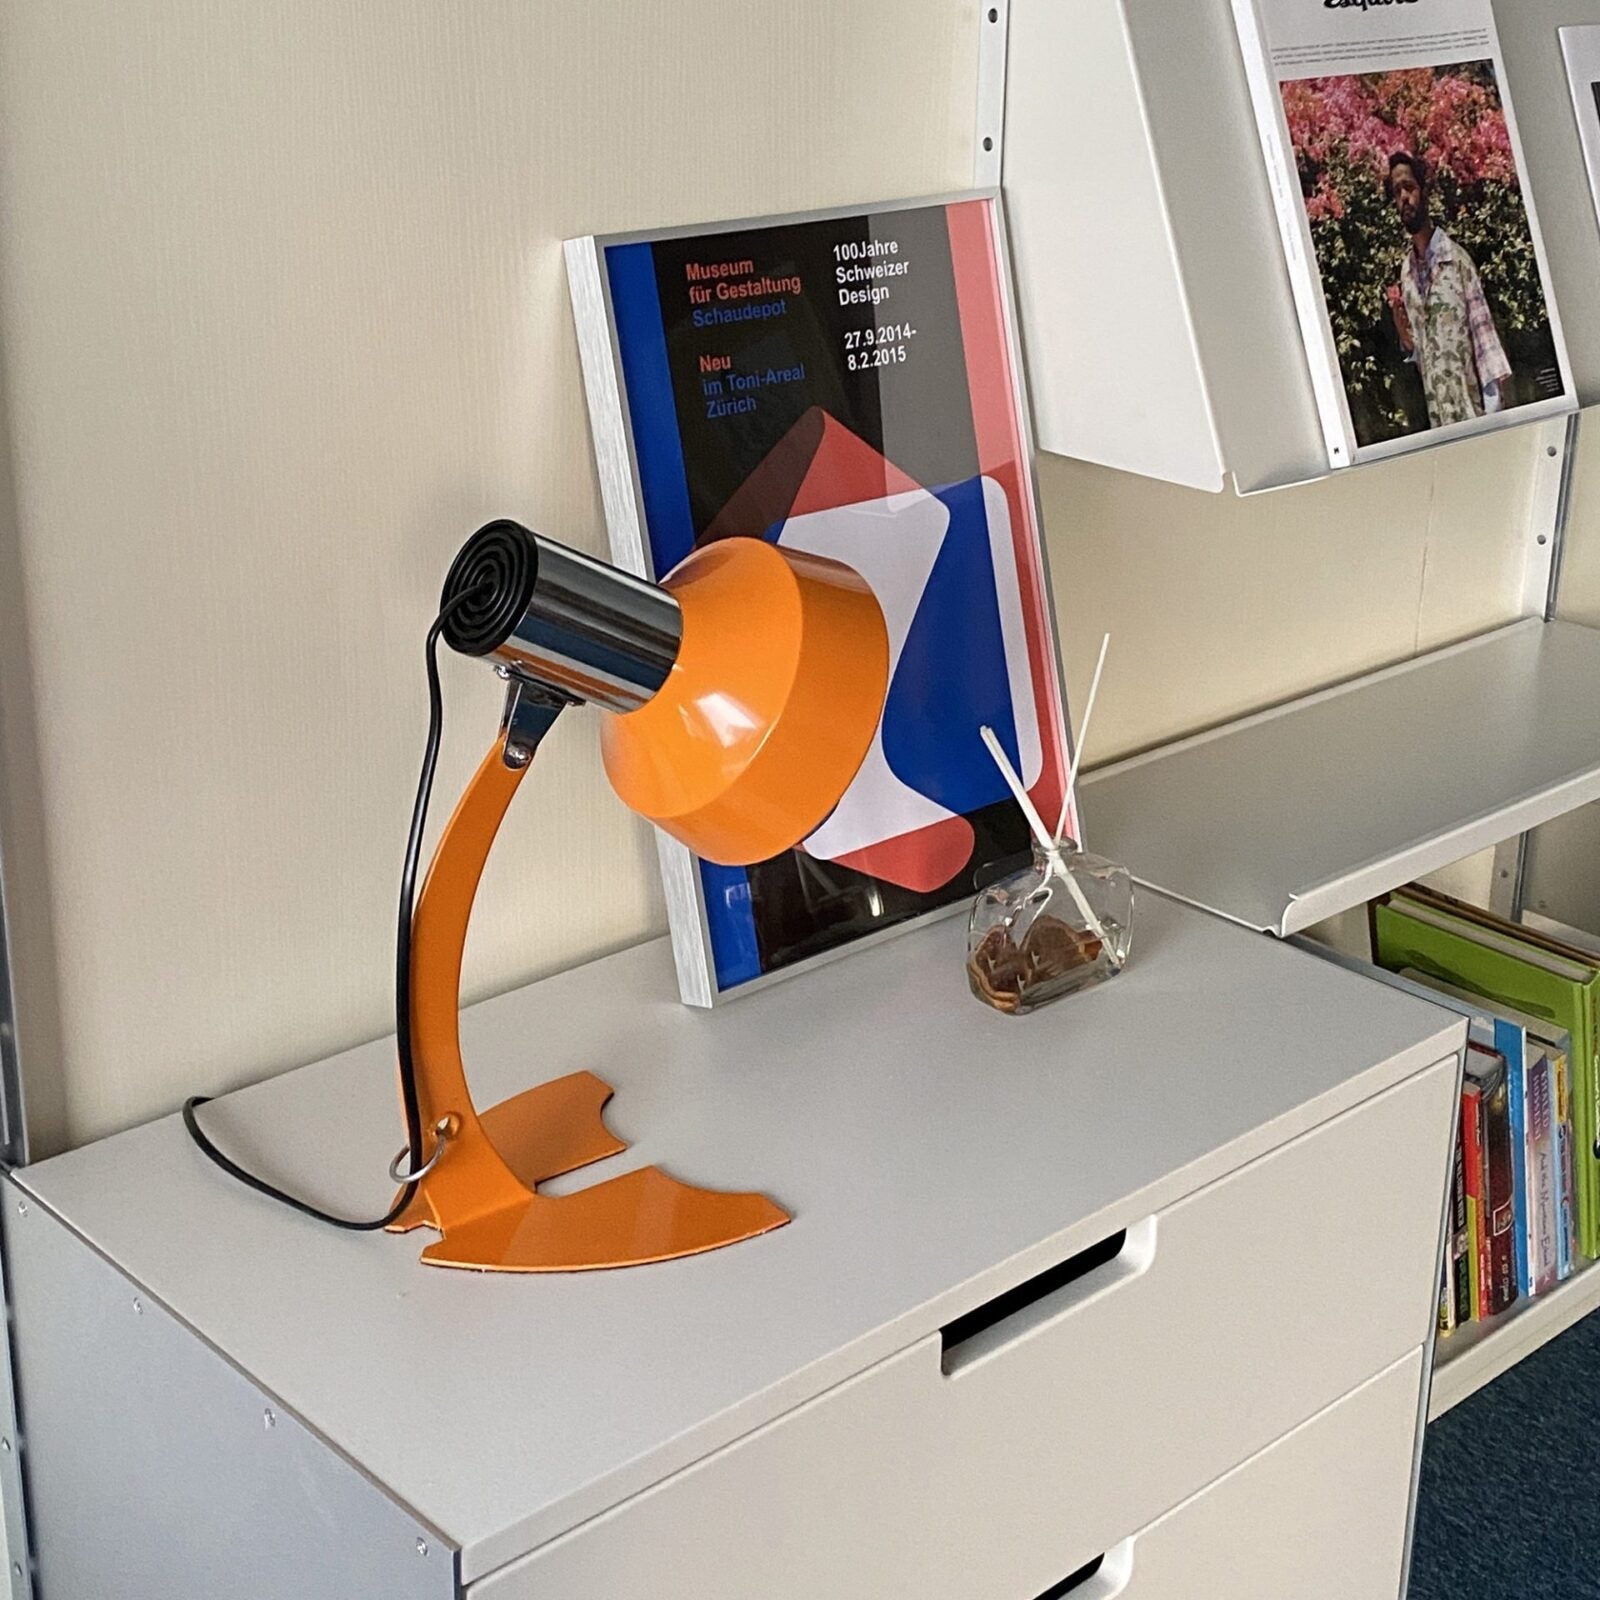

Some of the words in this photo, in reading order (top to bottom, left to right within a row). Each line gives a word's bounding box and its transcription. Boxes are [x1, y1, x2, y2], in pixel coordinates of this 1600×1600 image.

[1324, 0, 1418, 11] Esqu
[686, 260, 754, 280] Museum
[836, 260, 909, 284] Schweizer
[689, 286, 712, 304] für
[716, 277, 801, 299] Gestaltung
[839, 284, 890, 306] Design
[693, 299, 787, 327] Schaudepot
[844, 323, 917, 350] 27.9.2014-
[700, 354, 731, 373] Neu
[848, 346, 907, 371] 8.2.2015
[703, 379, 723, 396] im
[726, 362, 805, 391] Toni-Areal
[706, 395, 757, 418] Zürich
